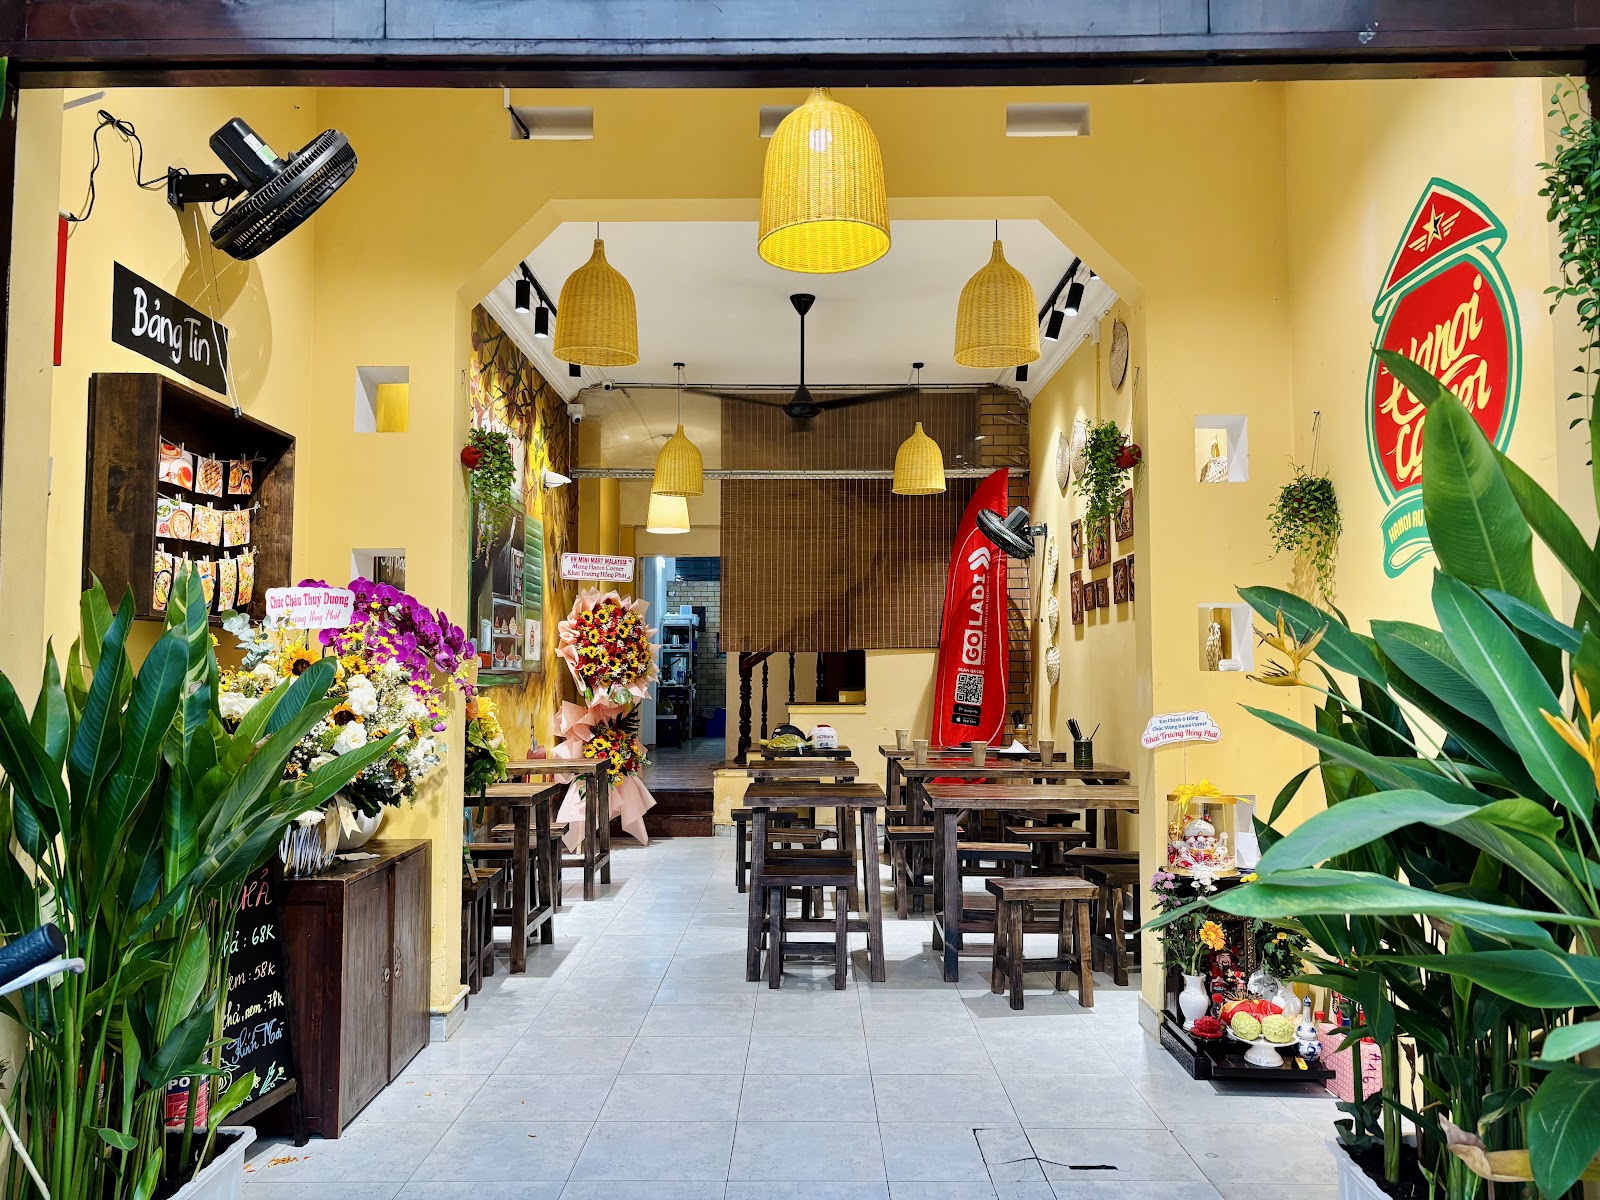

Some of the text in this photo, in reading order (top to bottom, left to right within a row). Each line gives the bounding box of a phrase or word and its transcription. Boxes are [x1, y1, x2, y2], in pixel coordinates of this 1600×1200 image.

[131, 286, 211, 366] Bảng Tin
[1388, 508, 1425, 544] HANOI AU
[604, 558, 627, 566] MALAYSIA
